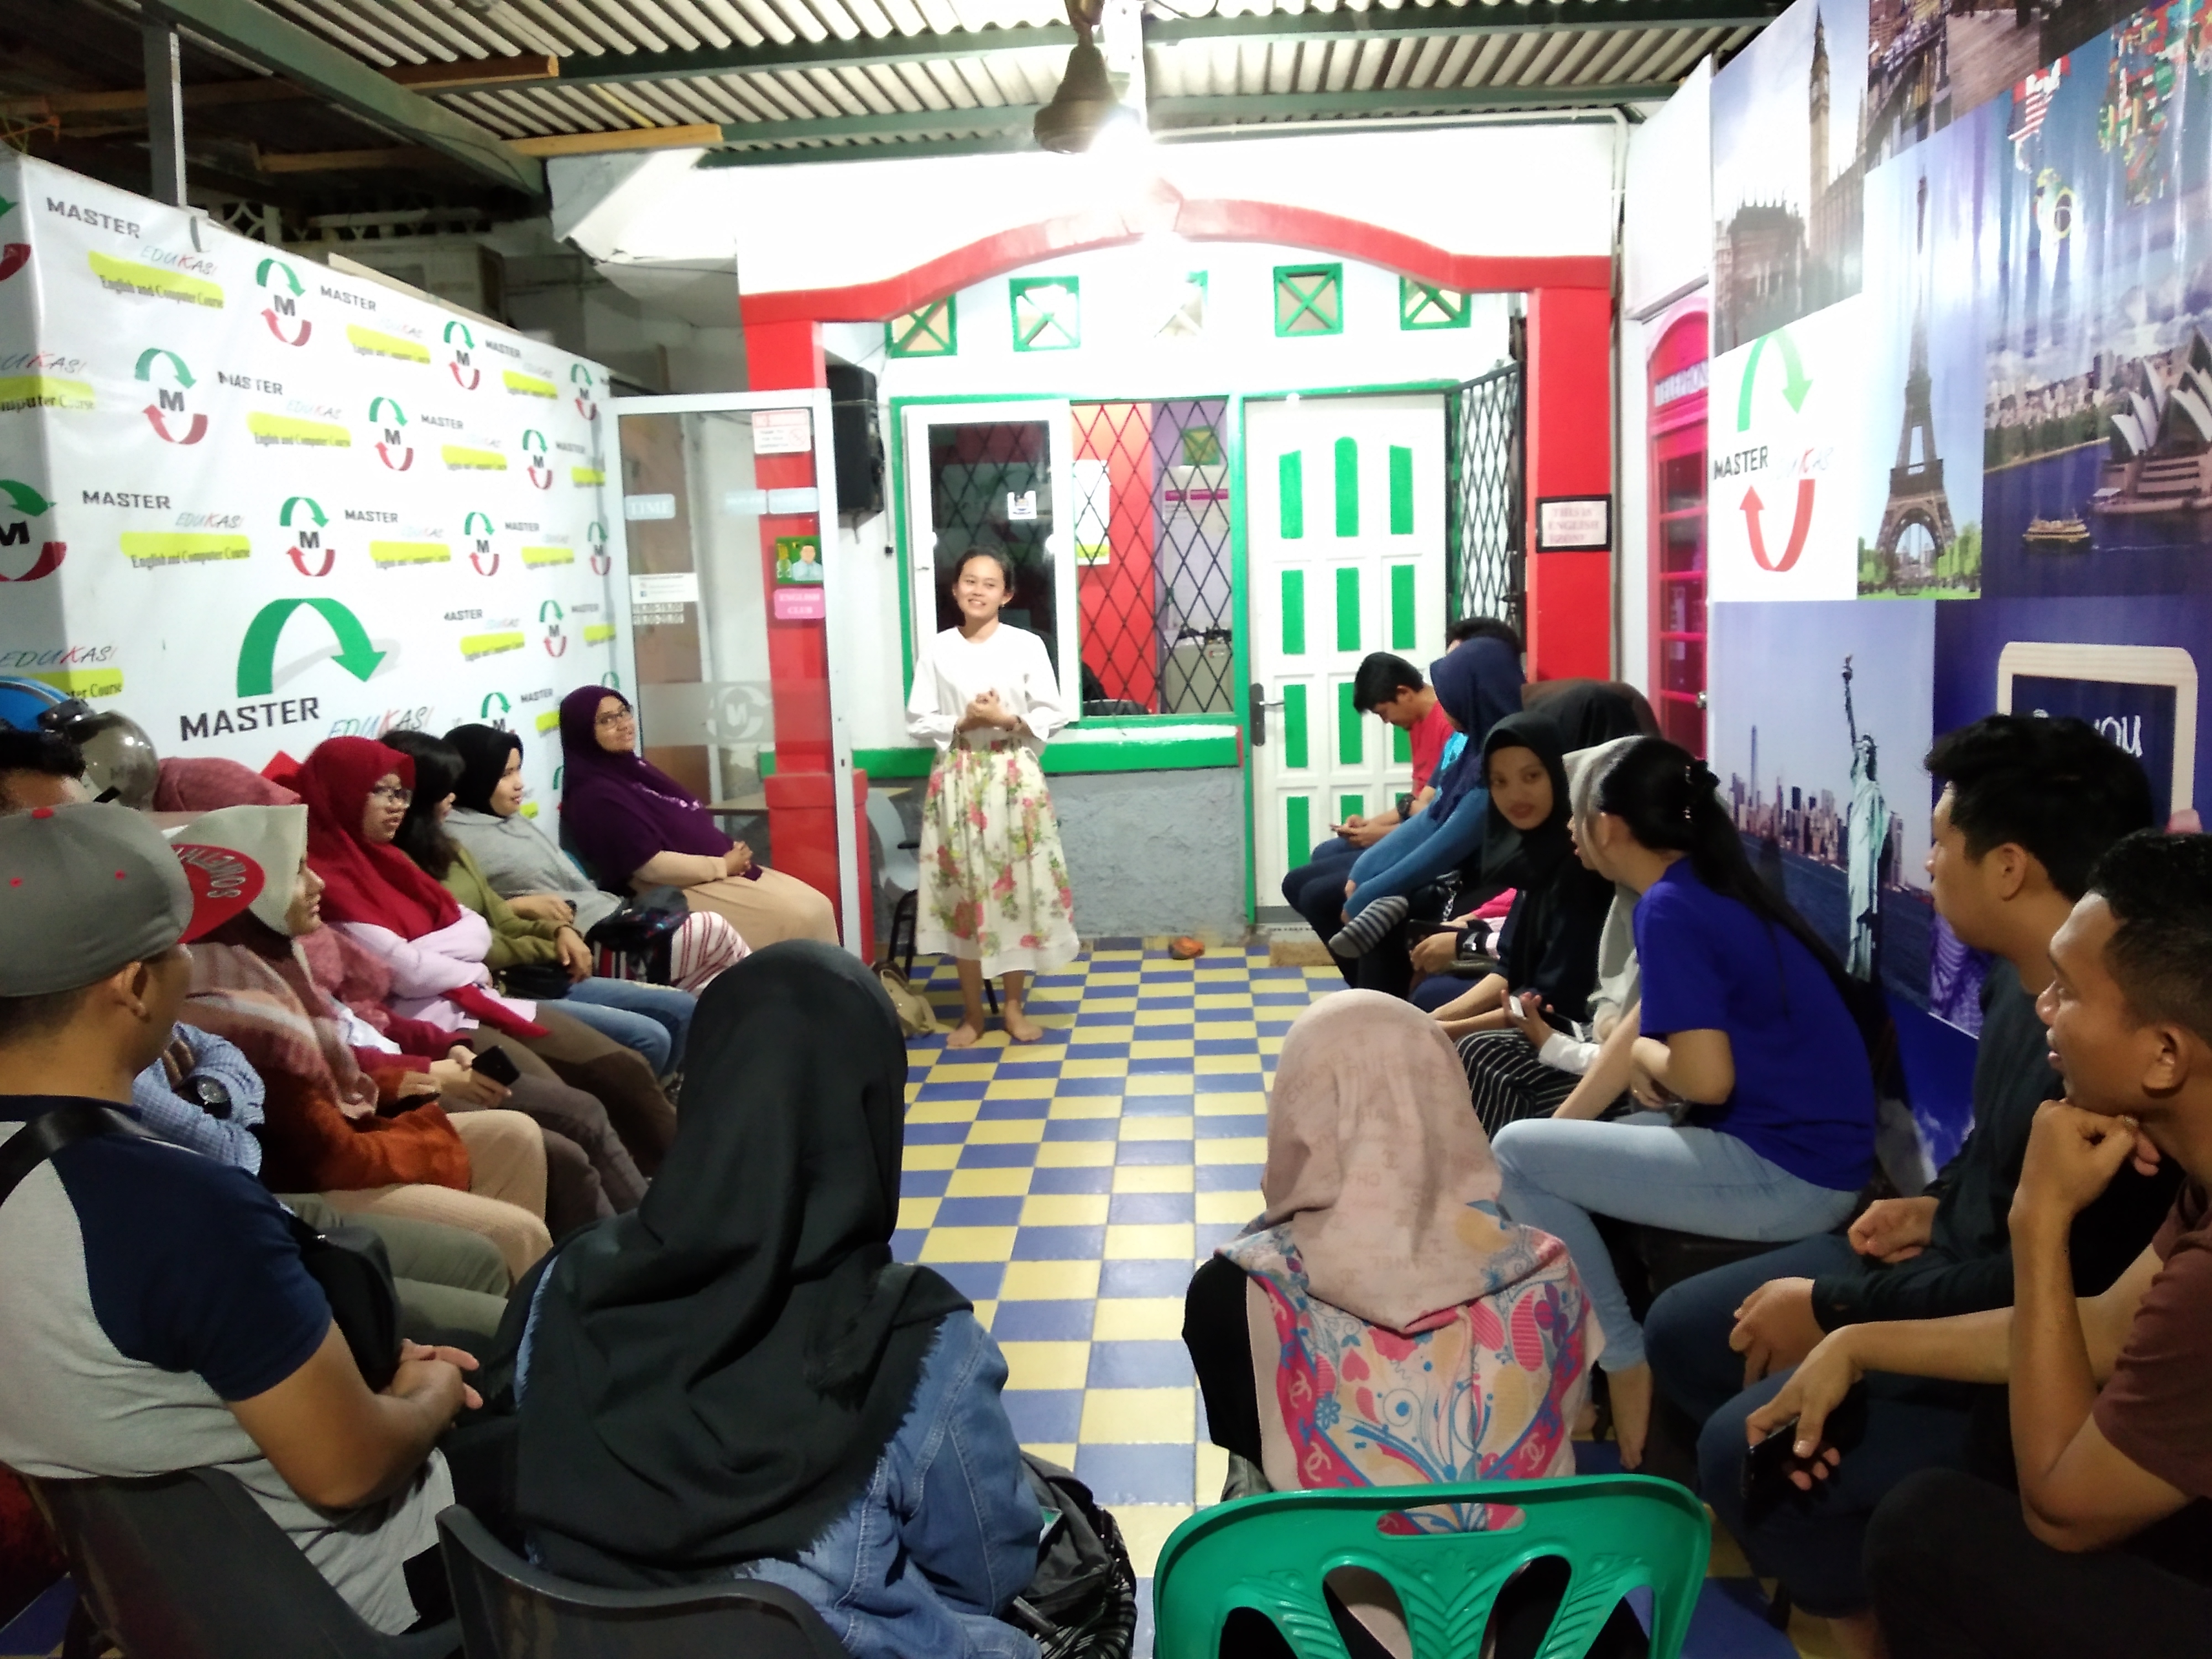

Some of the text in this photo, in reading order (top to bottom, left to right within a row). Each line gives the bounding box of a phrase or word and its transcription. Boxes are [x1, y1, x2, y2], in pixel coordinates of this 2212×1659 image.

[46, 197, 140, 238] MASTER
[141, 246, 217, 275] EDUKASI
[273, 294, 296, 317] M
[320, 285, 377, 311] MASTER
[456, 349, 470, 366] M
[485, 340, 521, 359] MASTER
[159, 388, 185, 412] M
[421, 414, 463, 430] MASTER
[384, 428, 401, 445] M
[533, 455, 544, 468] M
[1713, 445, 1768, 480] MASTER
[82, 490, 171, 509] MASTER
[630, 501, 671, 515] TIME
[345, 509, 398, 524] MASTER
[299, 530, 320, 549] M
[476, 539, 489, 553] M
[548, 624, 560, 638] M
[180, 697, 320, 742] MASTER
